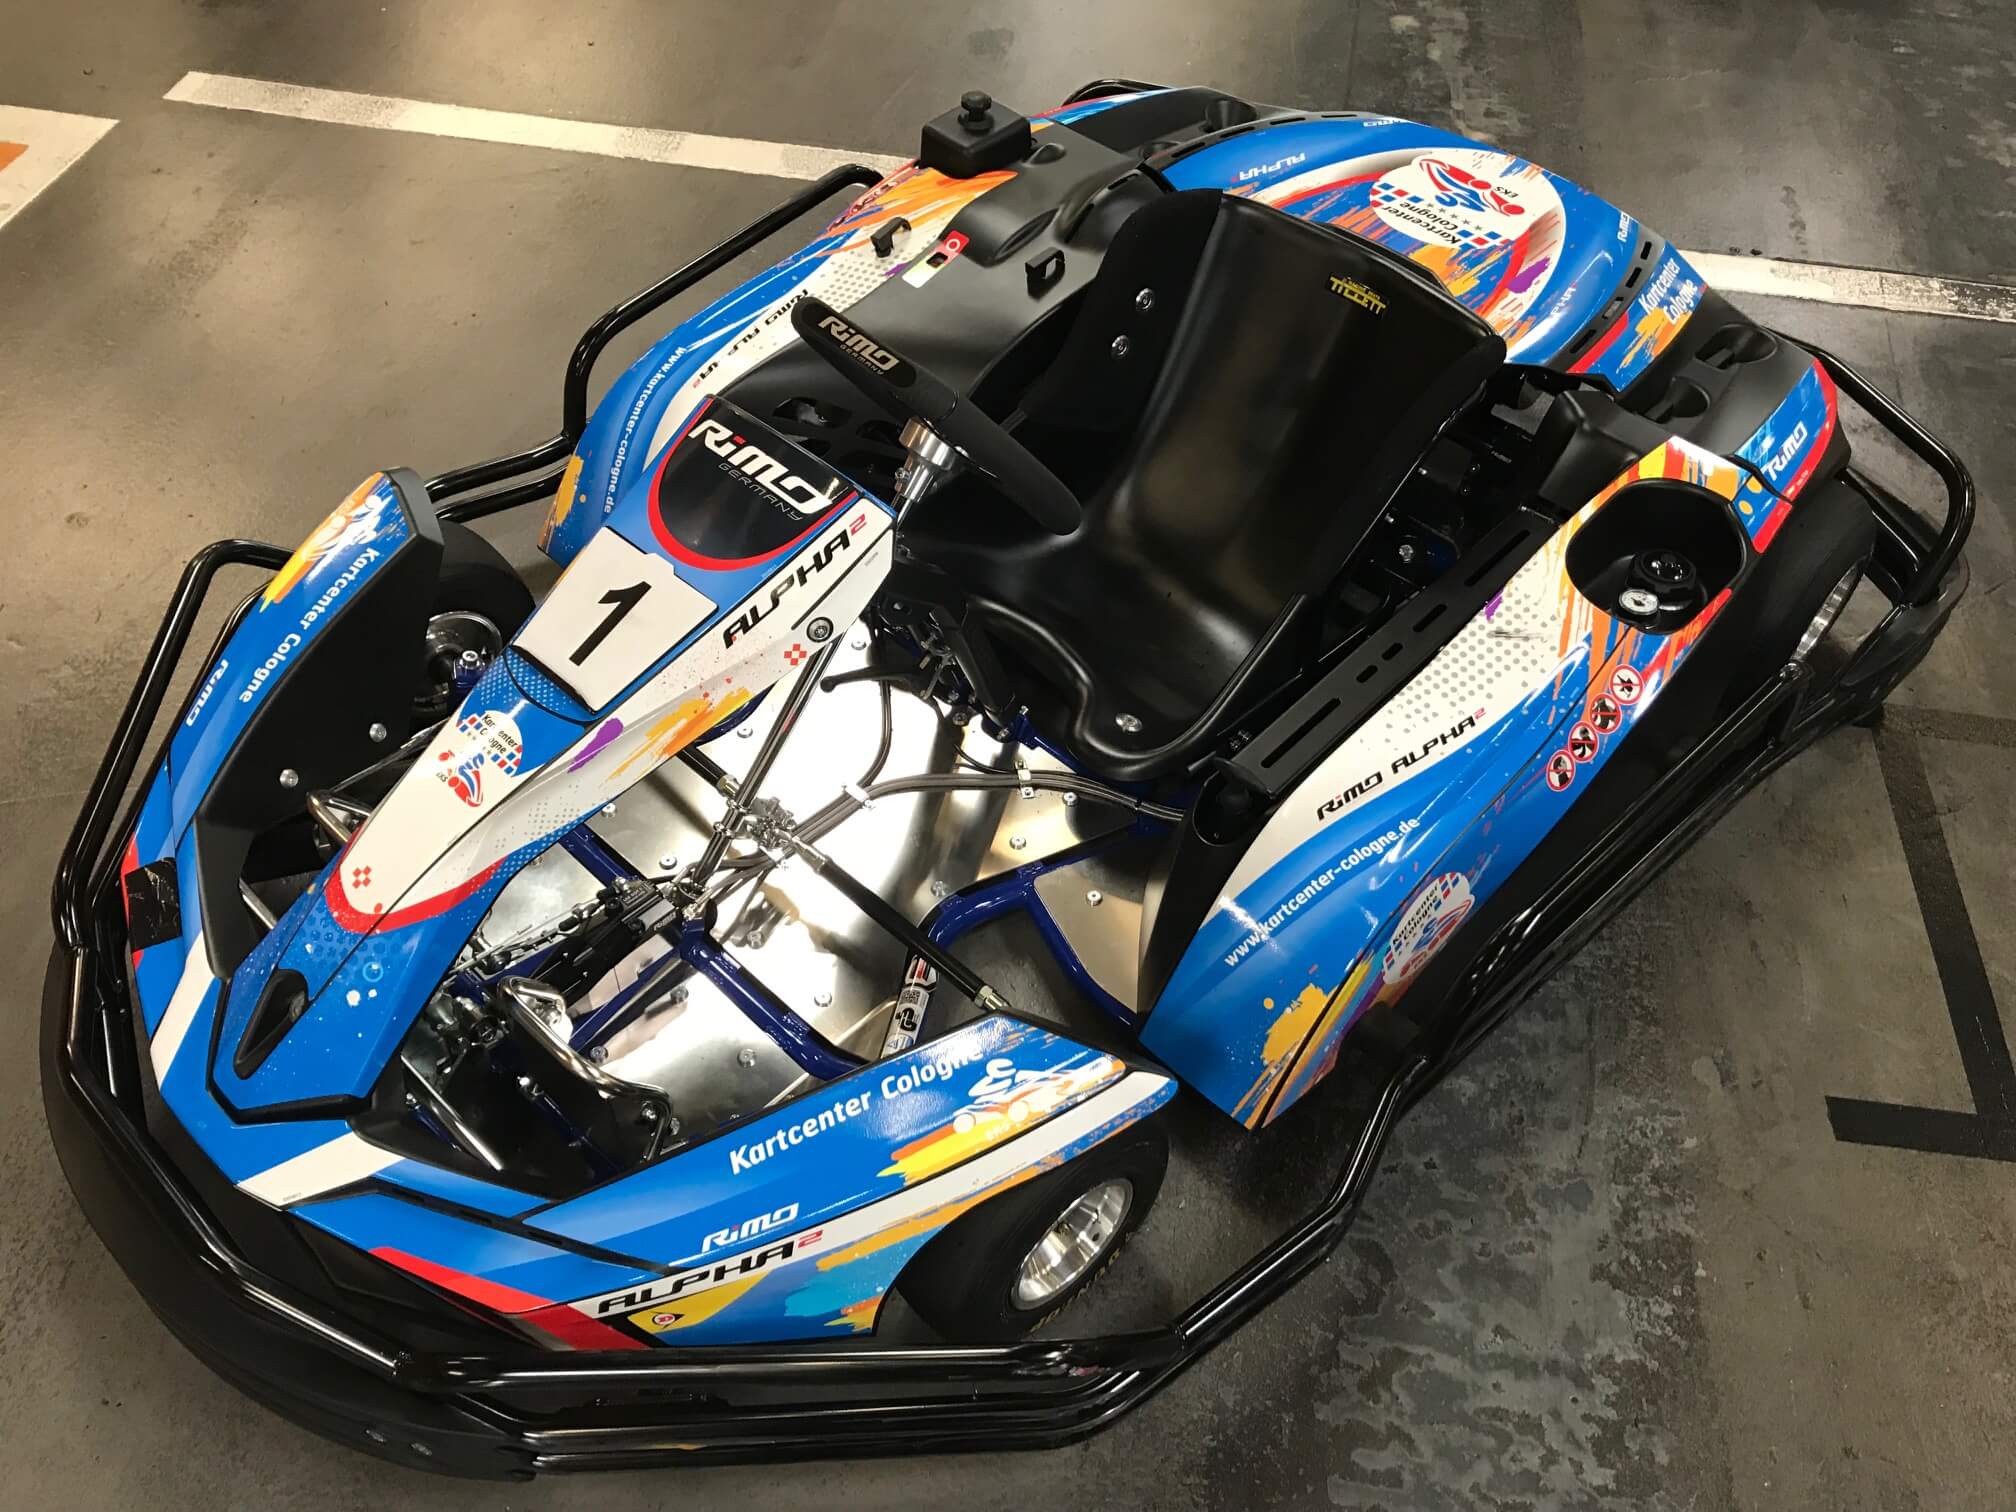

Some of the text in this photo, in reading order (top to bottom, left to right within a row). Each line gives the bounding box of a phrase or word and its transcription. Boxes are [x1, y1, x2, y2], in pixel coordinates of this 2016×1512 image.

[1399, 201, 1459, 232] Cologne
[1495, 186, 1519, 199] EKS
[1382, 204, 1462, 245] Kartcenter
[1638, 257, 1681, 314] Kartcenter
[1662, 278, 1698, 325] Cologne
[839, 344, 885, 376] GERMANY
[603, 346, 688, 514] www.kartcenter-cologne.de
[718, 462, 804, 521] GERMANY
[238, 547, 381, 704] Kartcenter Cologne
[568, 580, 652, 667] 1
[479, 727, 508, 754] Cogne
[482, 714, 519, 749] Karenter
[1223, 816, 1421, 968] www.kartcenter-cologne.de
[1392, 883, 1438, 945] Kartcenter
[1402, 895, 1438, 940] Cologne
[728, 1050, 984, 1176] Kartcenter Cologne
